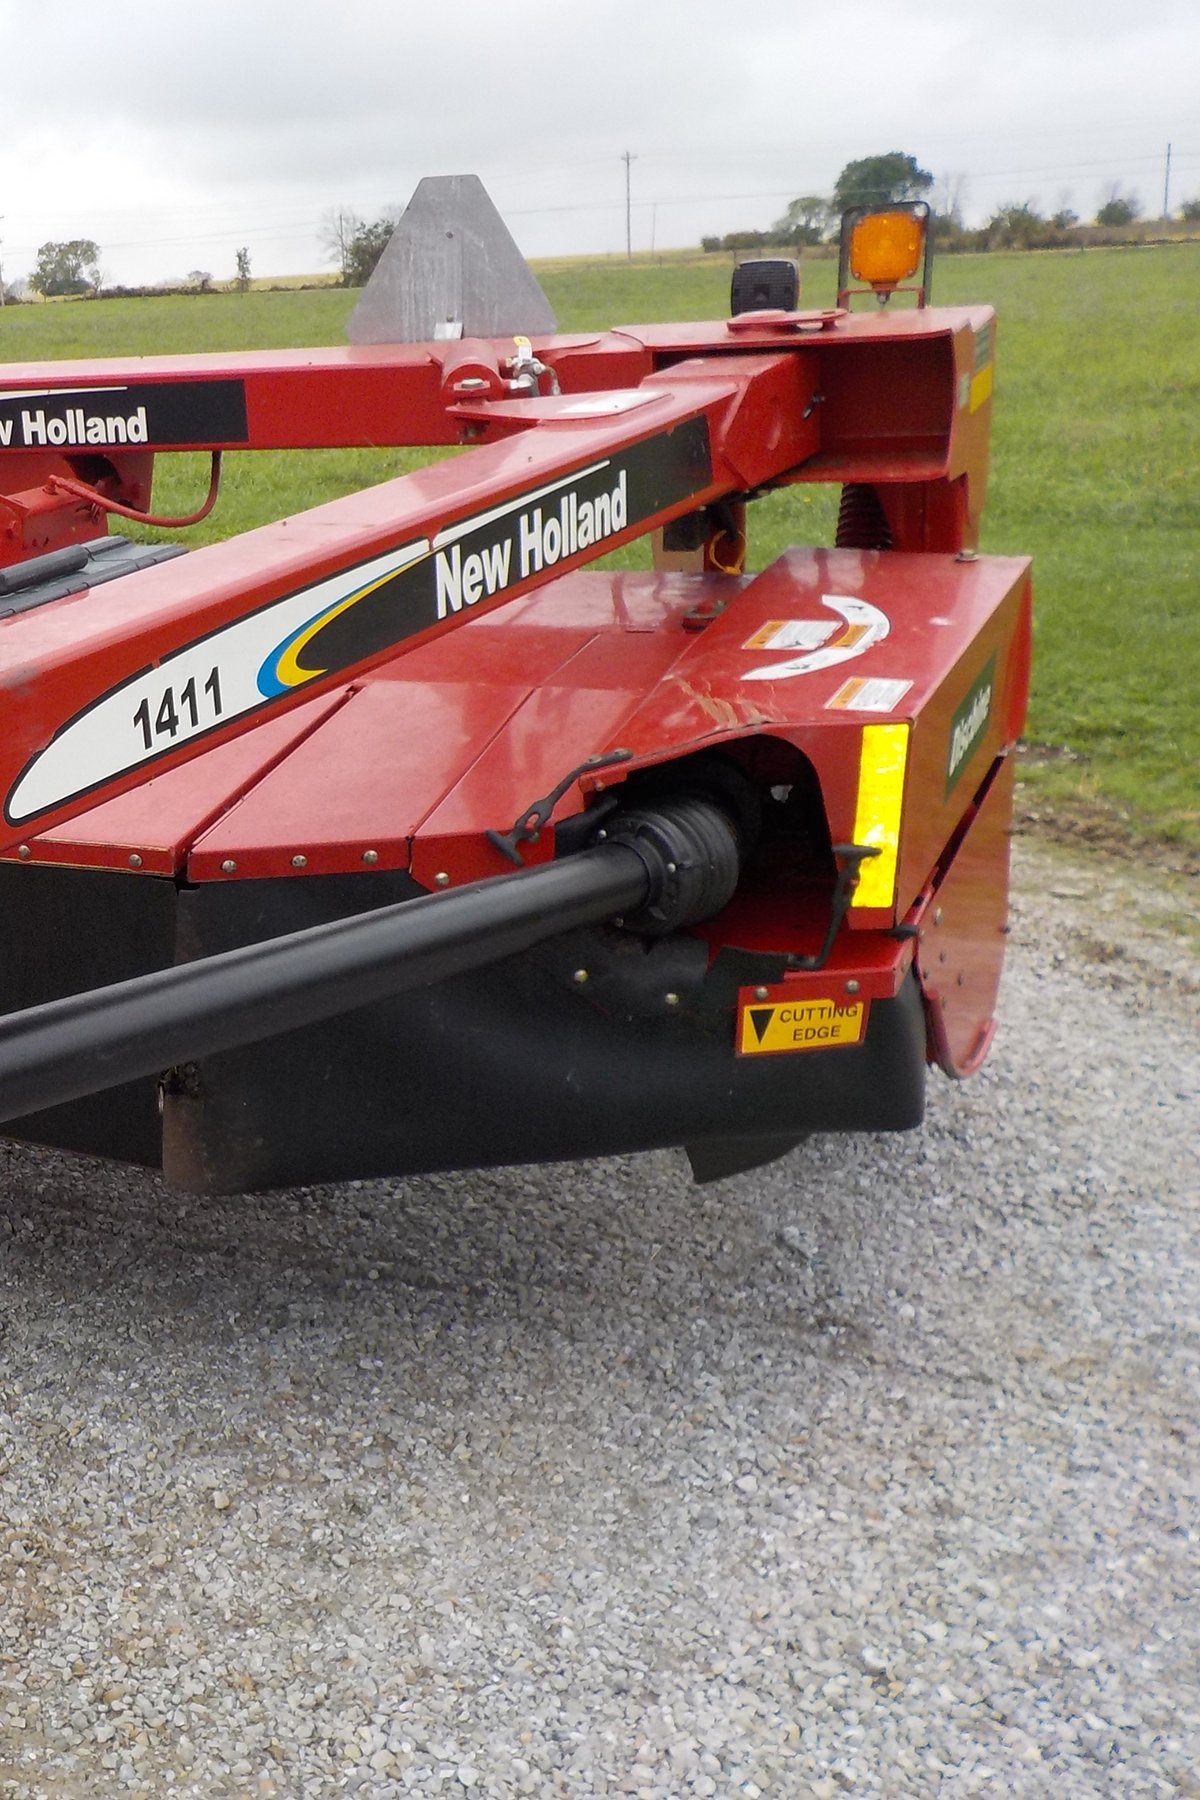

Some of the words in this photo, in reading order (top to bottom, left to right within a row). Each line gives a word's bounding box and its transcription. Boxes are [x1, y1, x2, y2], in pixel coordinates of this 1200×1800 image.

[21, 407, 149, 446] Holland
[434, 537, 512, 620] New
[519, 470, 628, 577] Holland
[132, 666, 225, 751] 1411
[780, 1005, 858, 1023] CUTTING
[792, 1025, 841, 1041] EDGE
